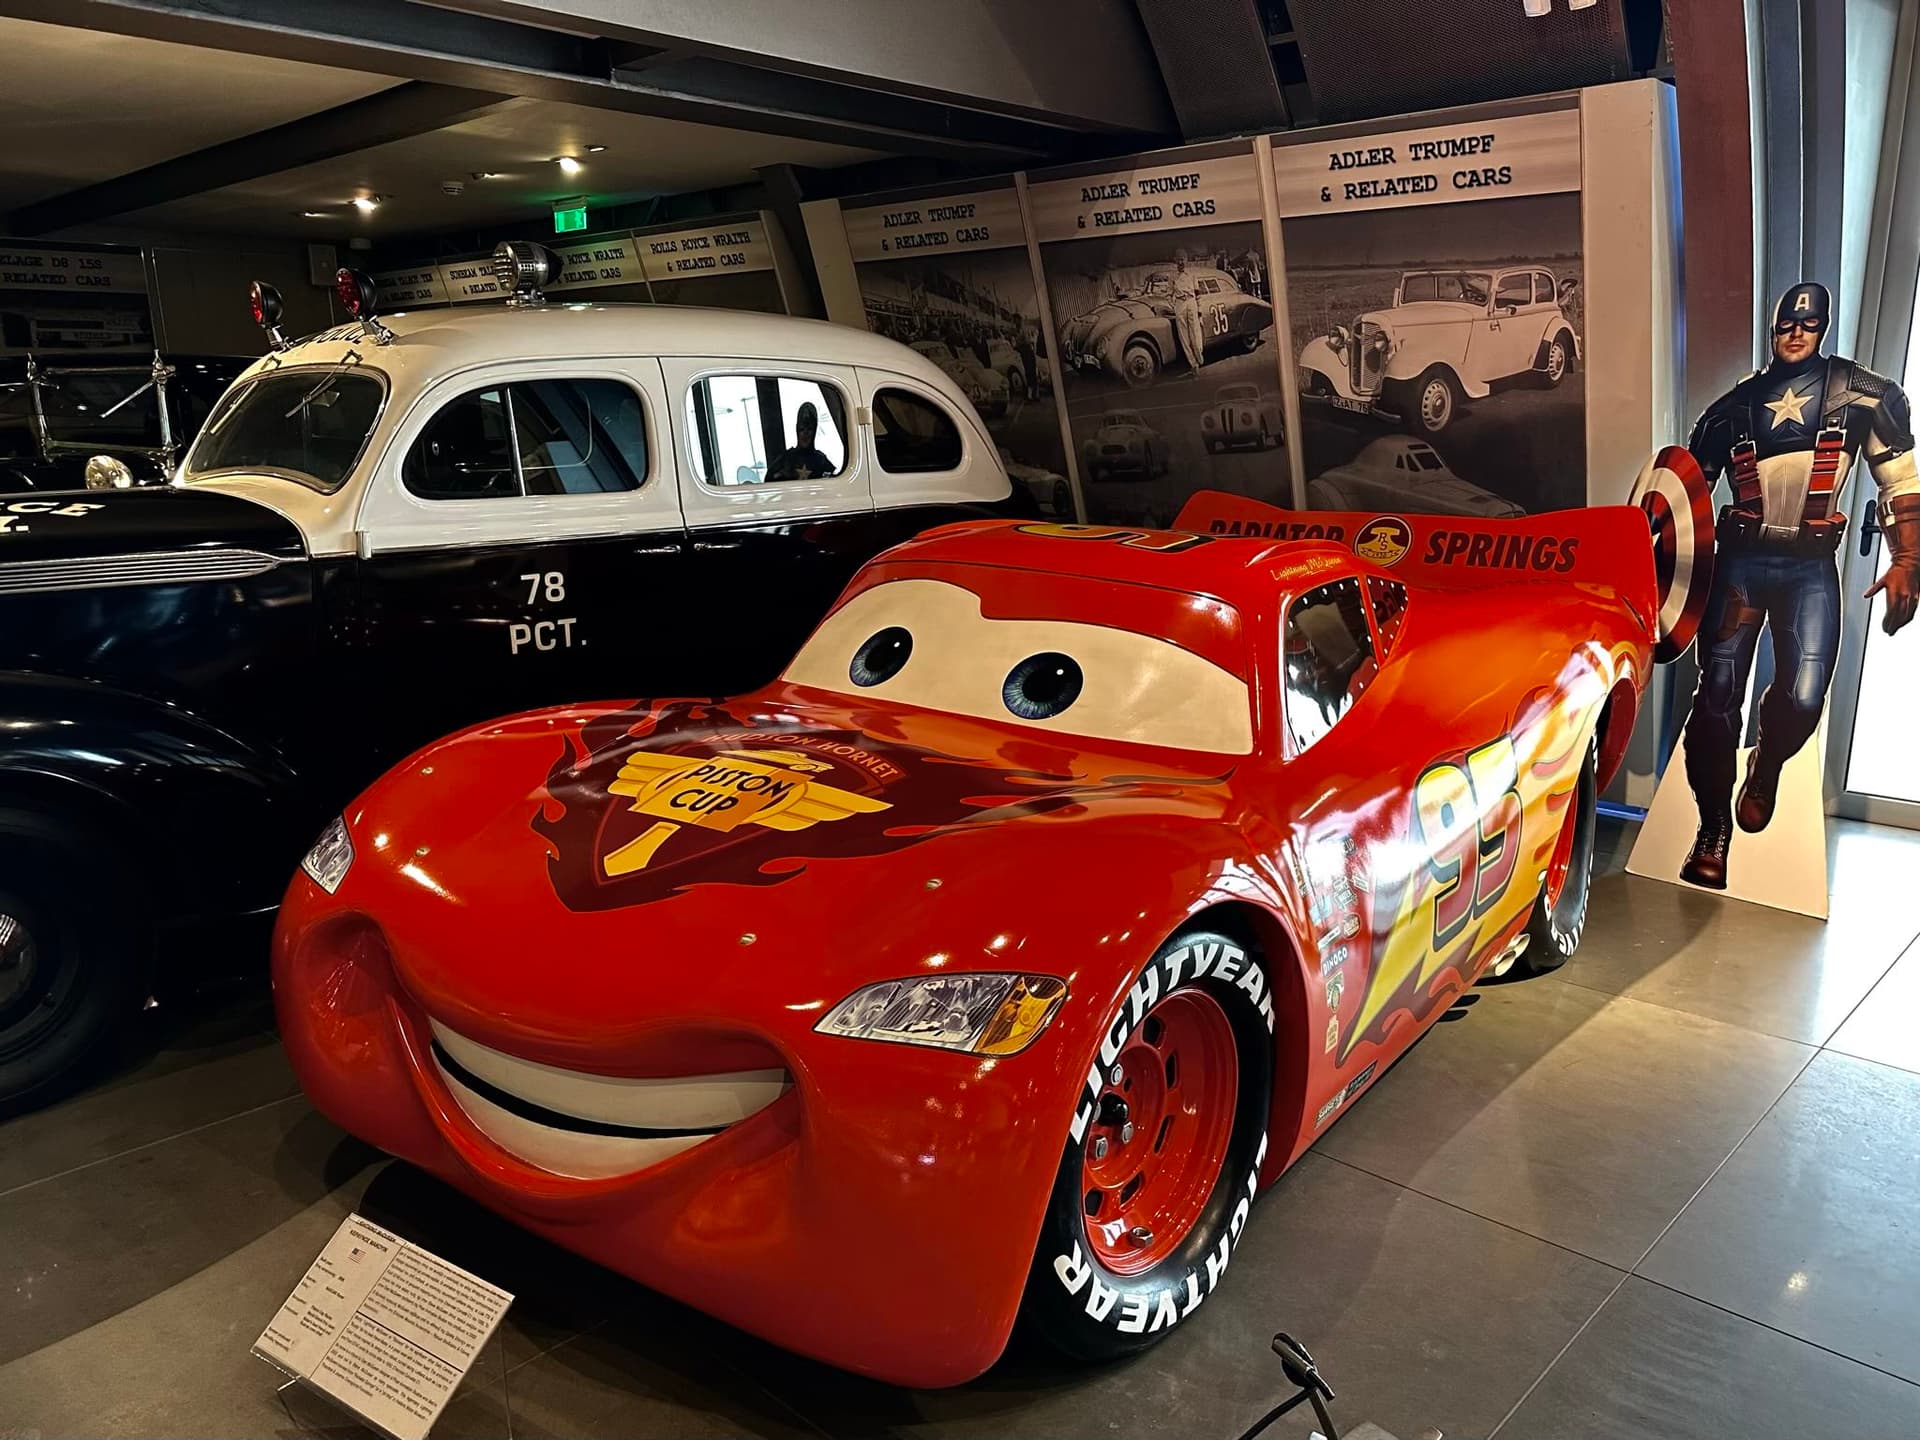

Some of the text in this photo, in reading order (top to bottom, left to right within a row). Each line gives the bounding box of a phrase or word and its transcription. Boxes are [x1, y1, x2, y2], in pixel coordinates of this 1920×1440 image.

[1329, 134, 1495, 170] ADLER TRUMPF
[1082, 174, 1200, 202] ADLER TRUMPF
[1320, 166, 1512, 201] & RELATED CARS
[884, 204, 976, 227] ADLER TRUMPF
[1077, 200, 1216, 228] & RELATED CARS
[650, 231, 750, 254] ROLLS ROYCE WRAITH
[882, 227, 989, 250] & RELATED CARS
[593, 248, 625, 262] WRAITH
[677, 257, 715, 271] RELATED
[720, 252, 746, 265] CARS
[2, 272, 111, 286] RELATED CARS
[564, 267, 622, 283] RELATED CARS
[1794, 293, 1810, 311] A
[1208, 303, 1230, 336] 35
[1424, 530, 1580, 574] SPRINGS
[520, 571, 566, 605] 78
[509, 617, 587, 655] PCT.
[702, 733, 898, 779] HUDSON HORNET
[684, 765, 795, 799] PISTON
[669, 788, 739, 815] CUP
[1407, 734, 1523, 953] 95
[1322, 946, 1349, 977] DINOCO
[1053, 1130, 1268, 1334] LIGHTYEAR
